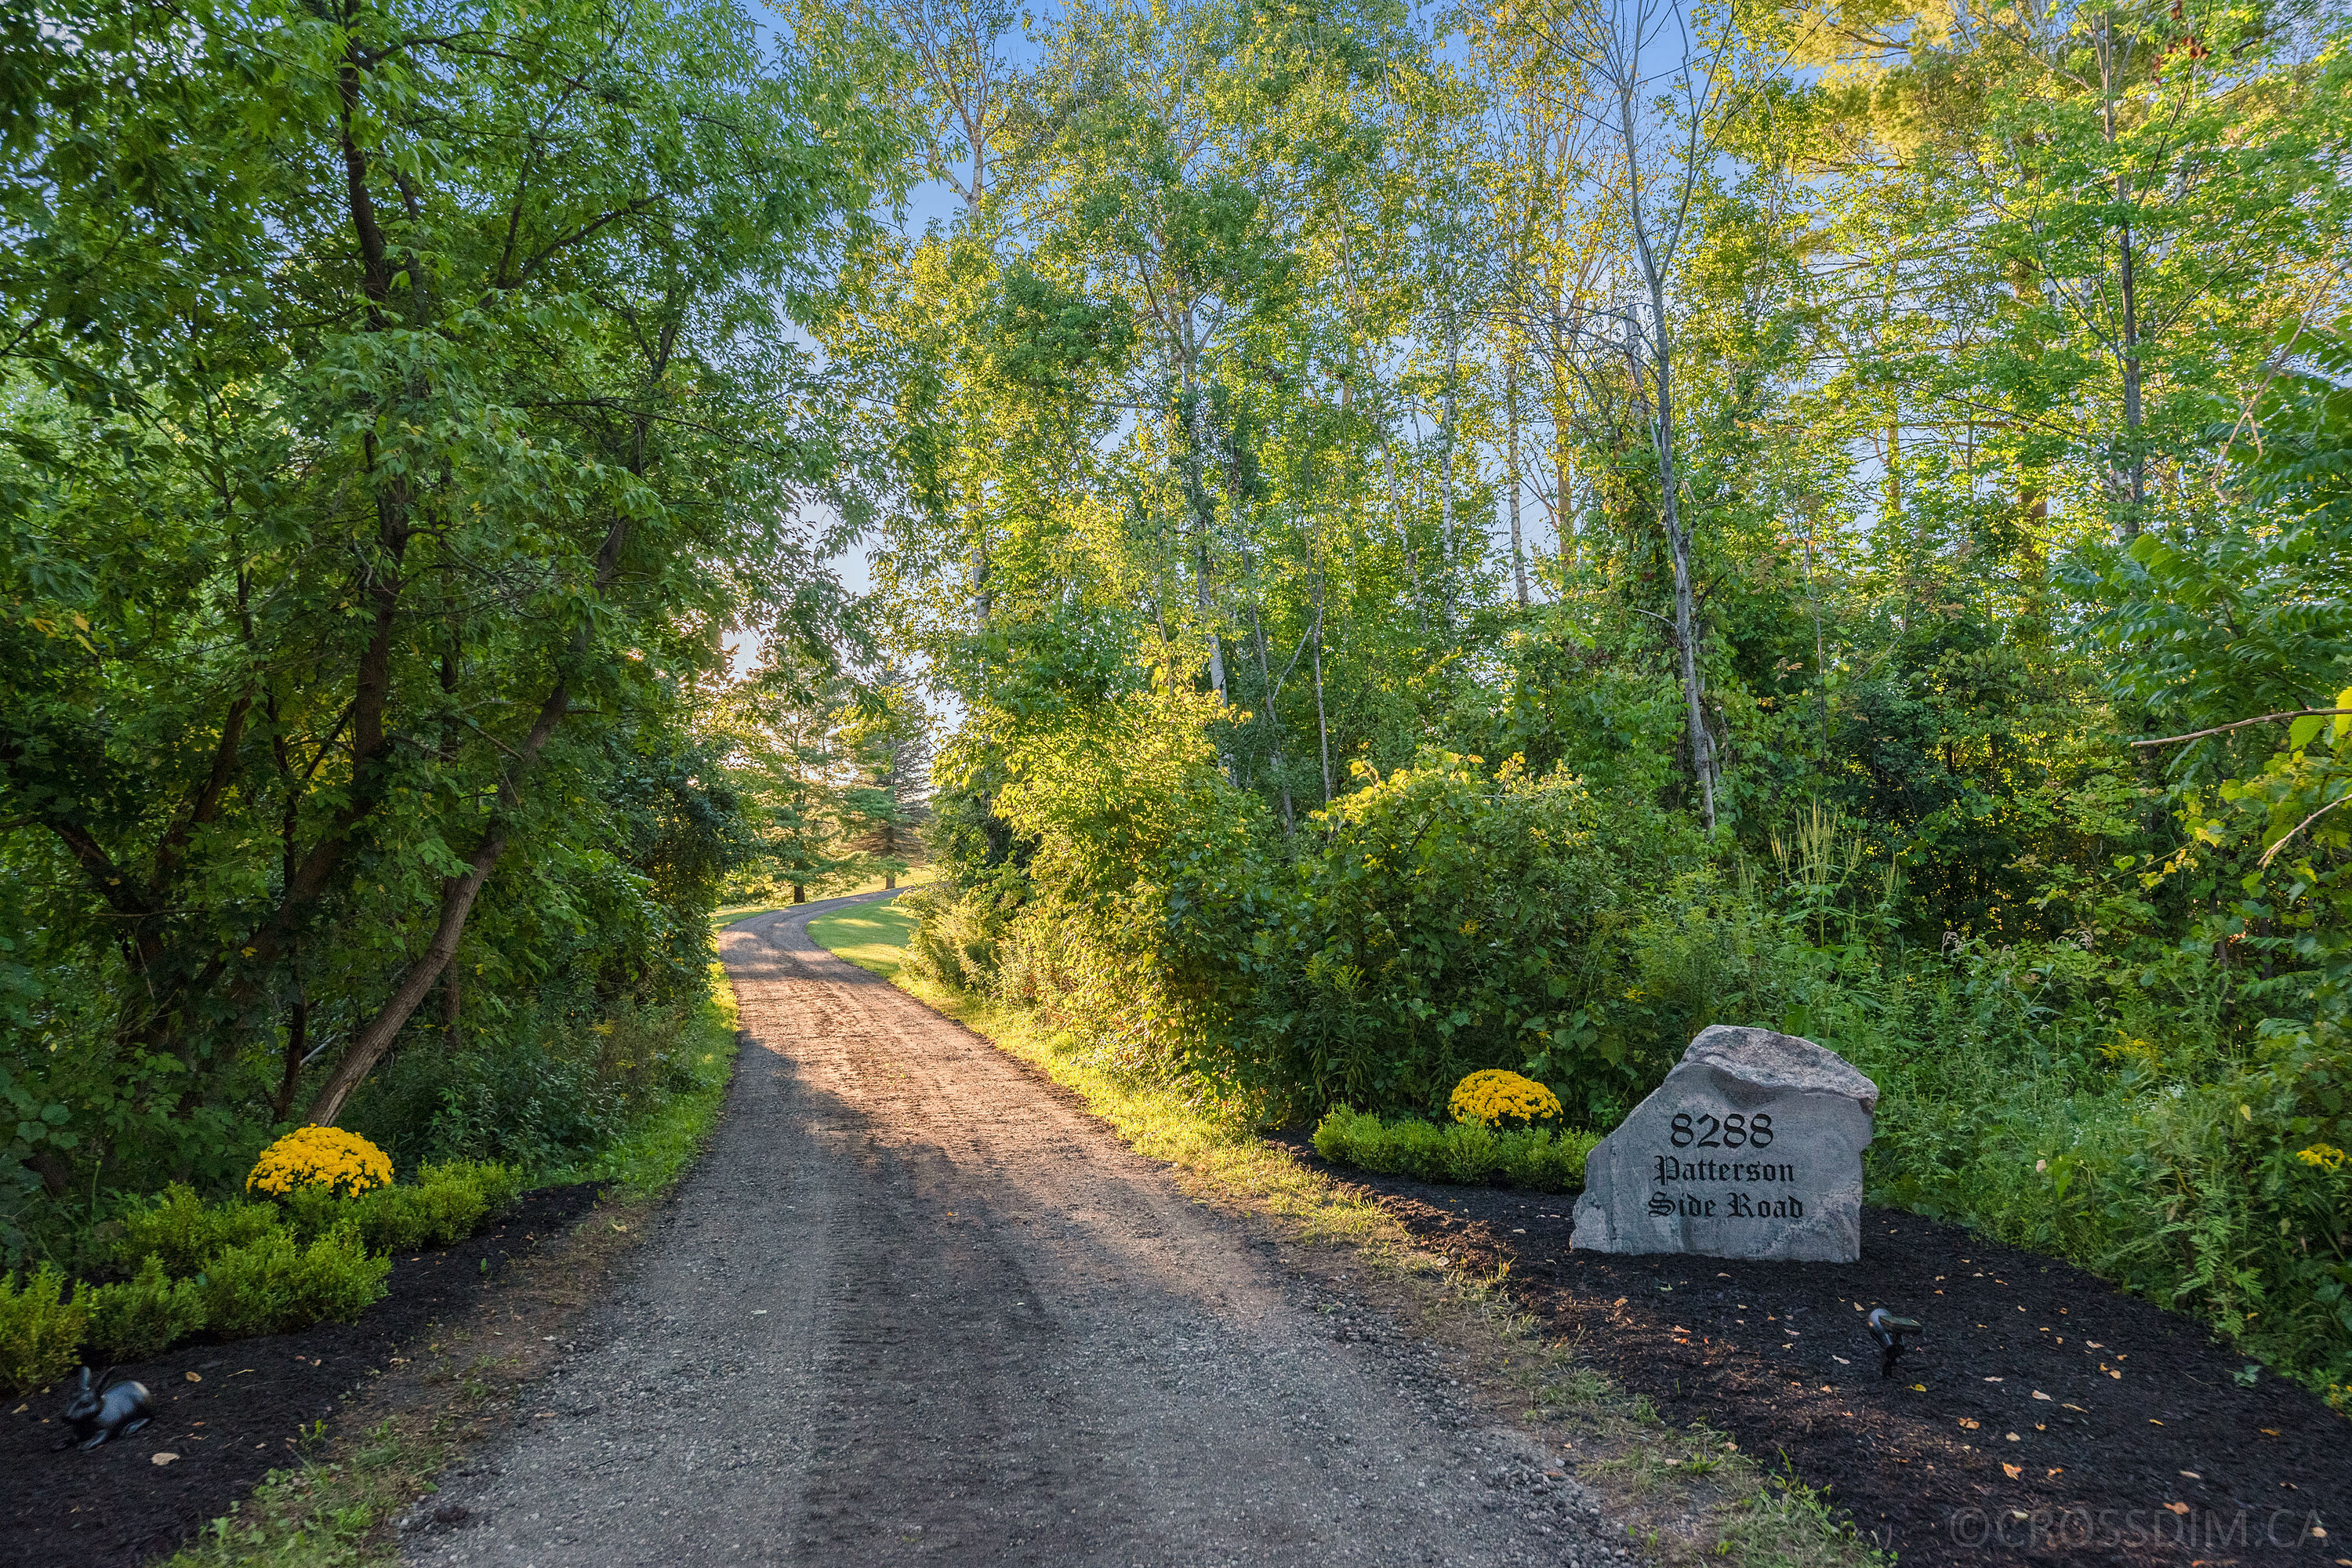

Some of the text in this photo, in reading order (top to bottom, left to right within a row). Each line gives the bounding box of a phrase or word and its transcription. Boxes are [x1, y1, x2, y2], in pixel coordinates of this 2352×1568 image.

[1670, 1112, 1774, 1149] 8288
[1653, 1155, 1795, 1186] Patterson
[1647, 1191, 1804, 1219] Side Road
